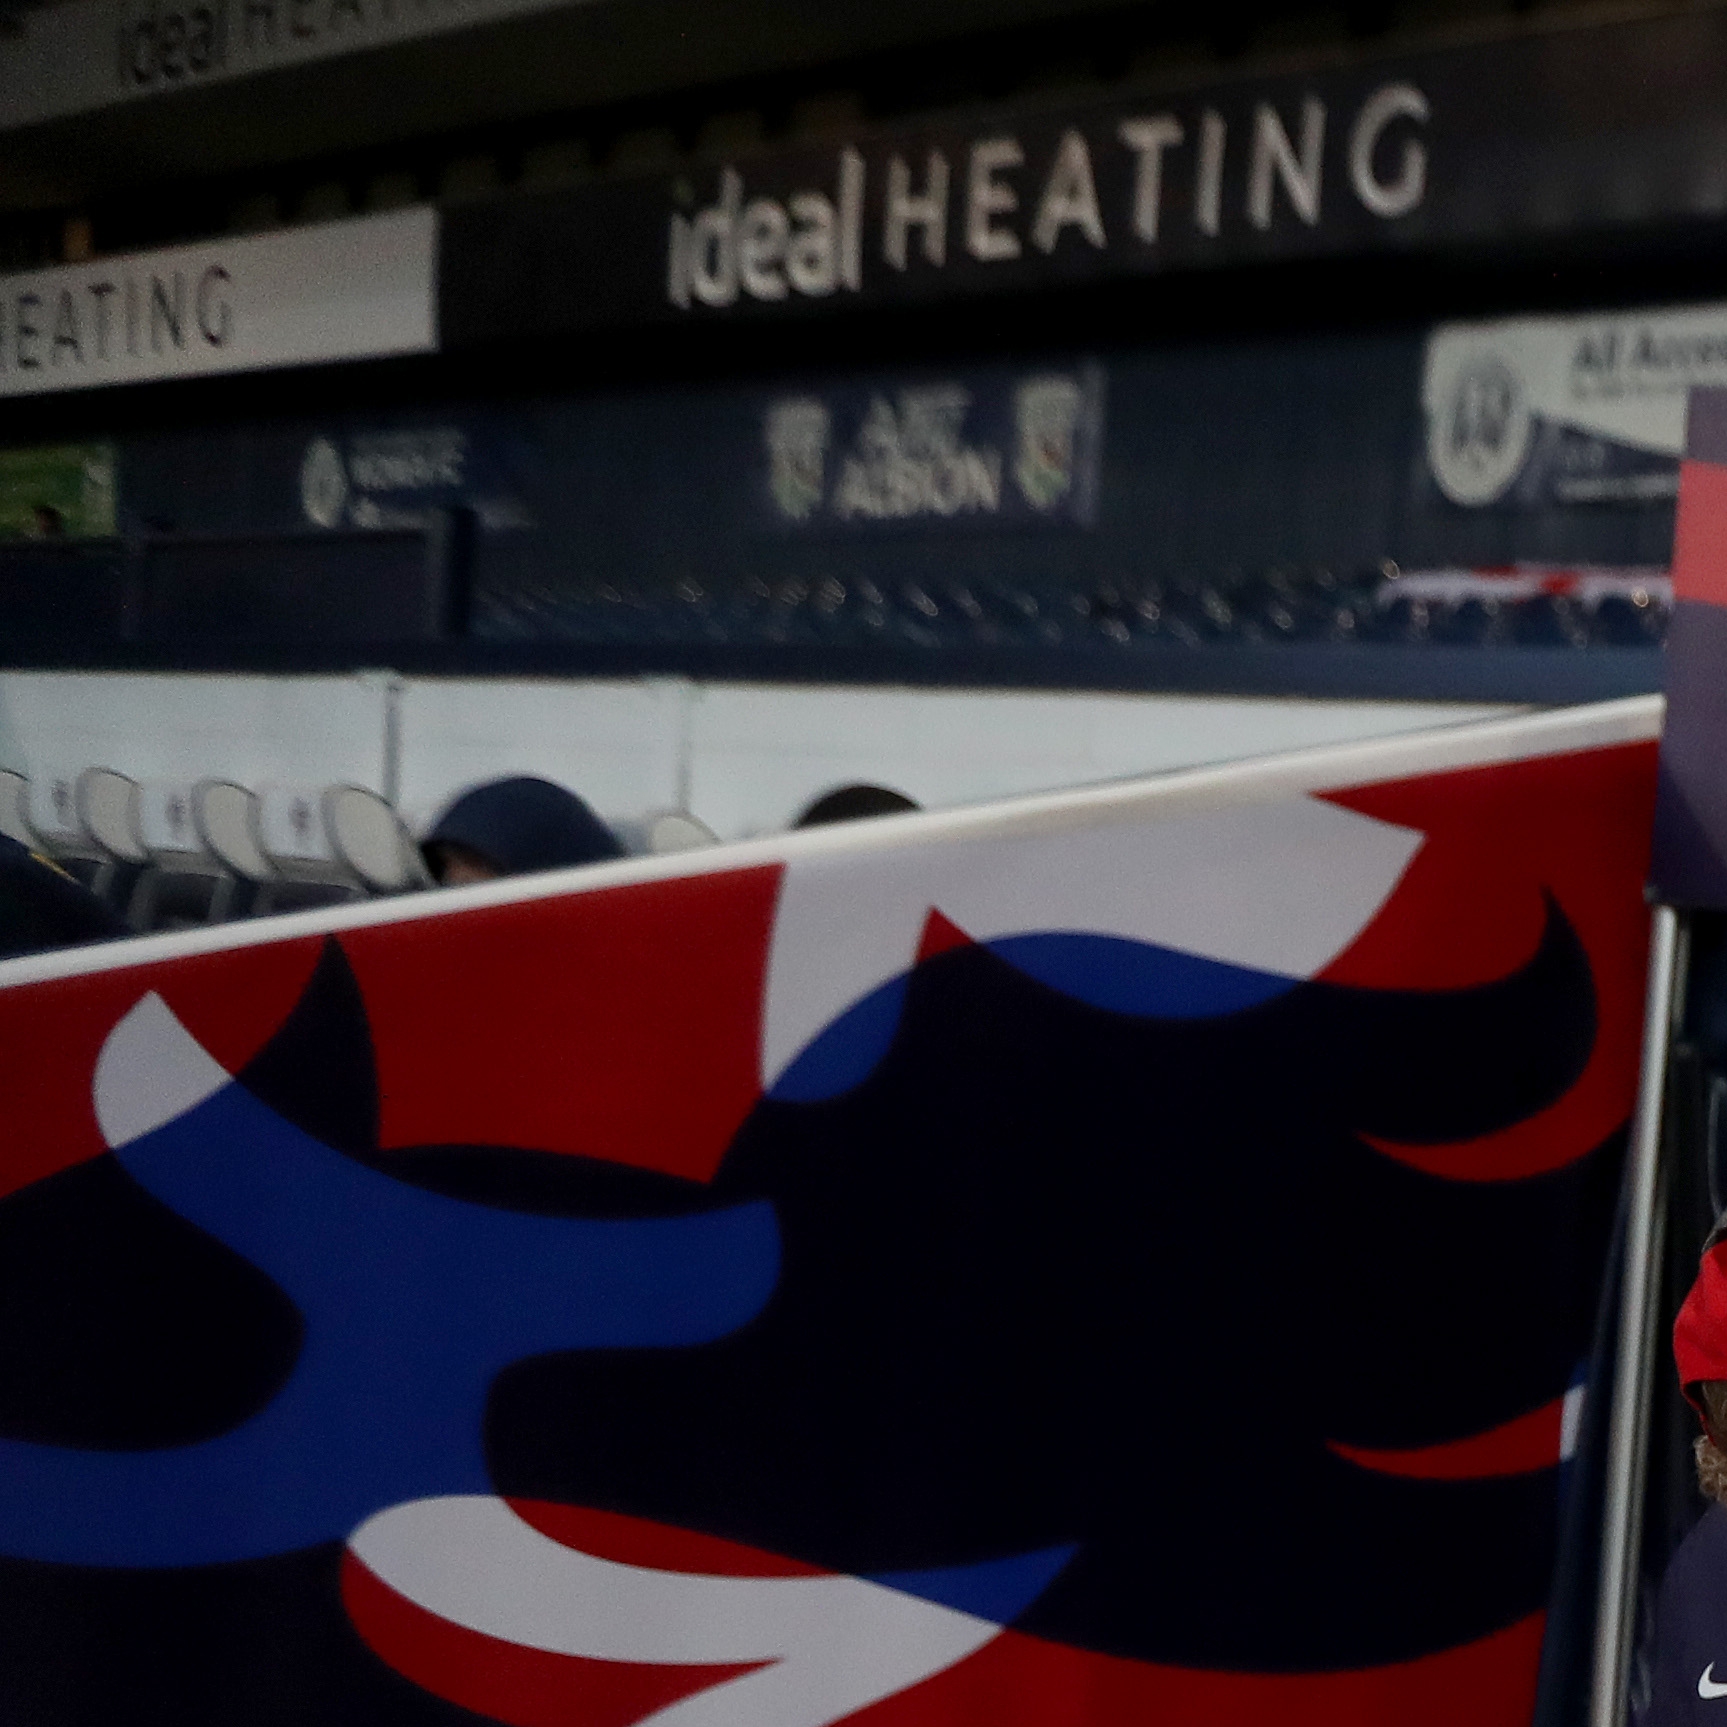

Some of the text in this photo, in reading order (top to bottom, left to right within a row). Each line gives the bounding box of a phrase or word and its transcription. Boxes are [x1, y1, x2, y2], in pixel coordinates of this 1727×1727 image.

[666, 80, 1430, 310] ideal HEATING
[0, 263, 233, 376] EATING
